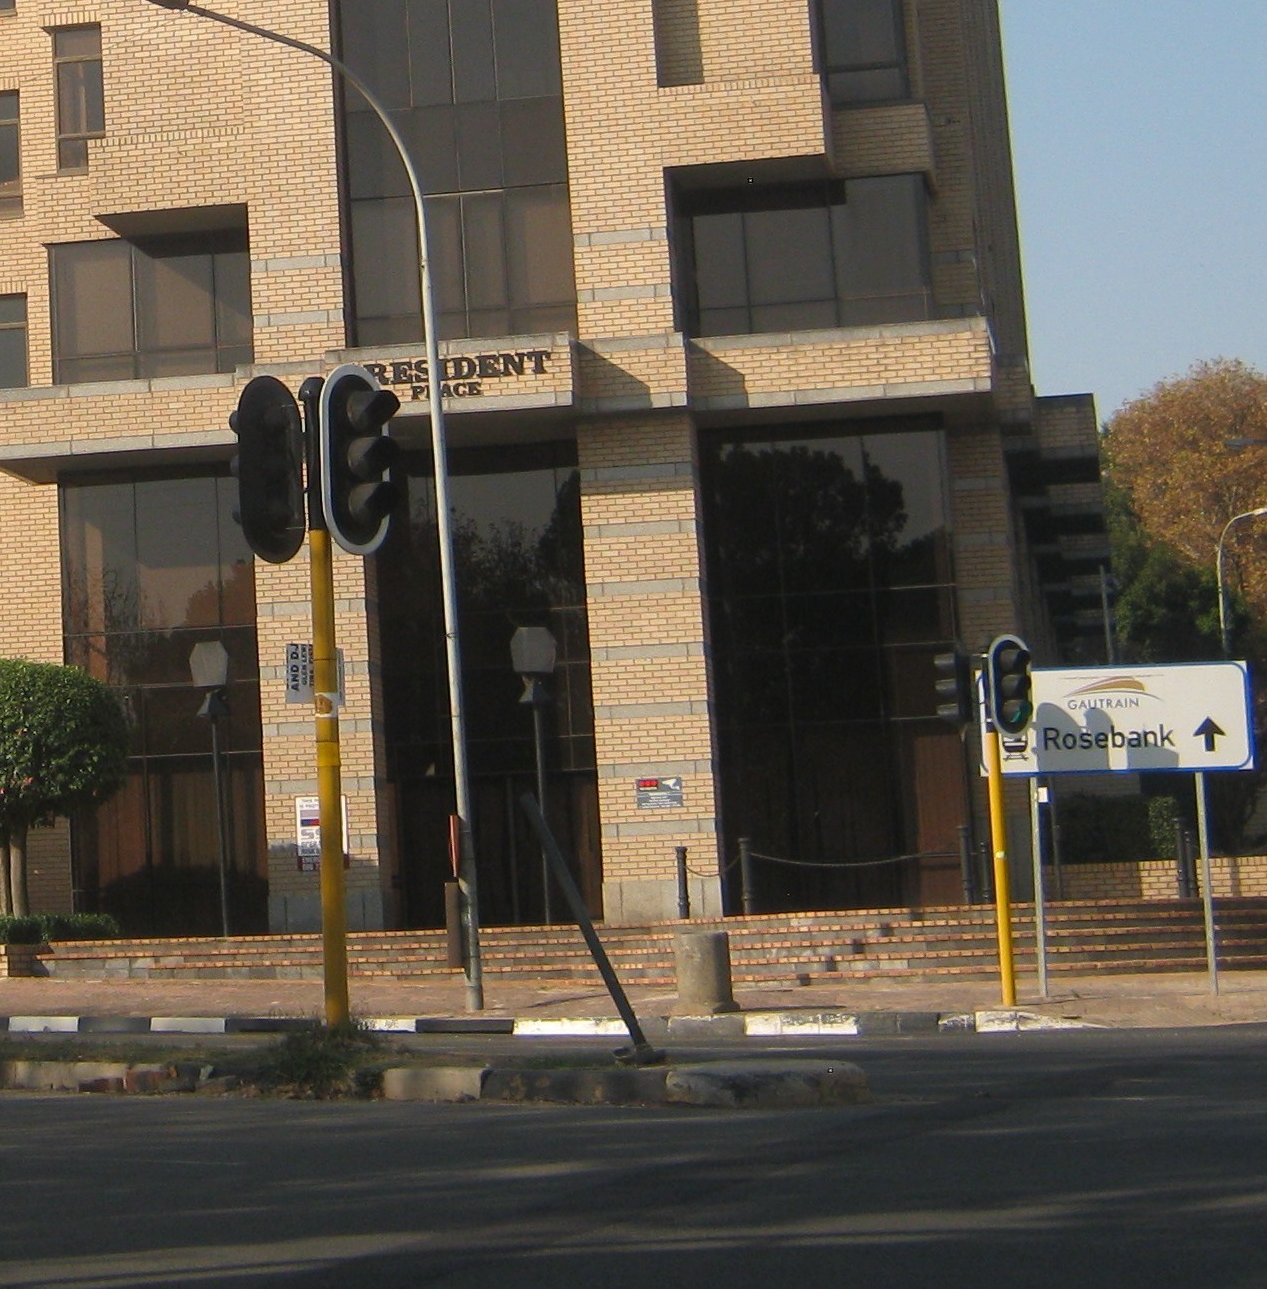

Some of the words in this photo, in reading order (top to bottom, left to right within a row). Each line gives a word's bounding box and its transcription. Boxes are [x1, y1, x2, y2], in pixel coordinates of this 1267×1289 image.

[362, 350, 551, 386] RESIDENT
[290, 664, 300, 692] AND
[1067, 697, 1140, 711] GAUTRAIN
[1042, 723, 1176, 751] Rosebank
